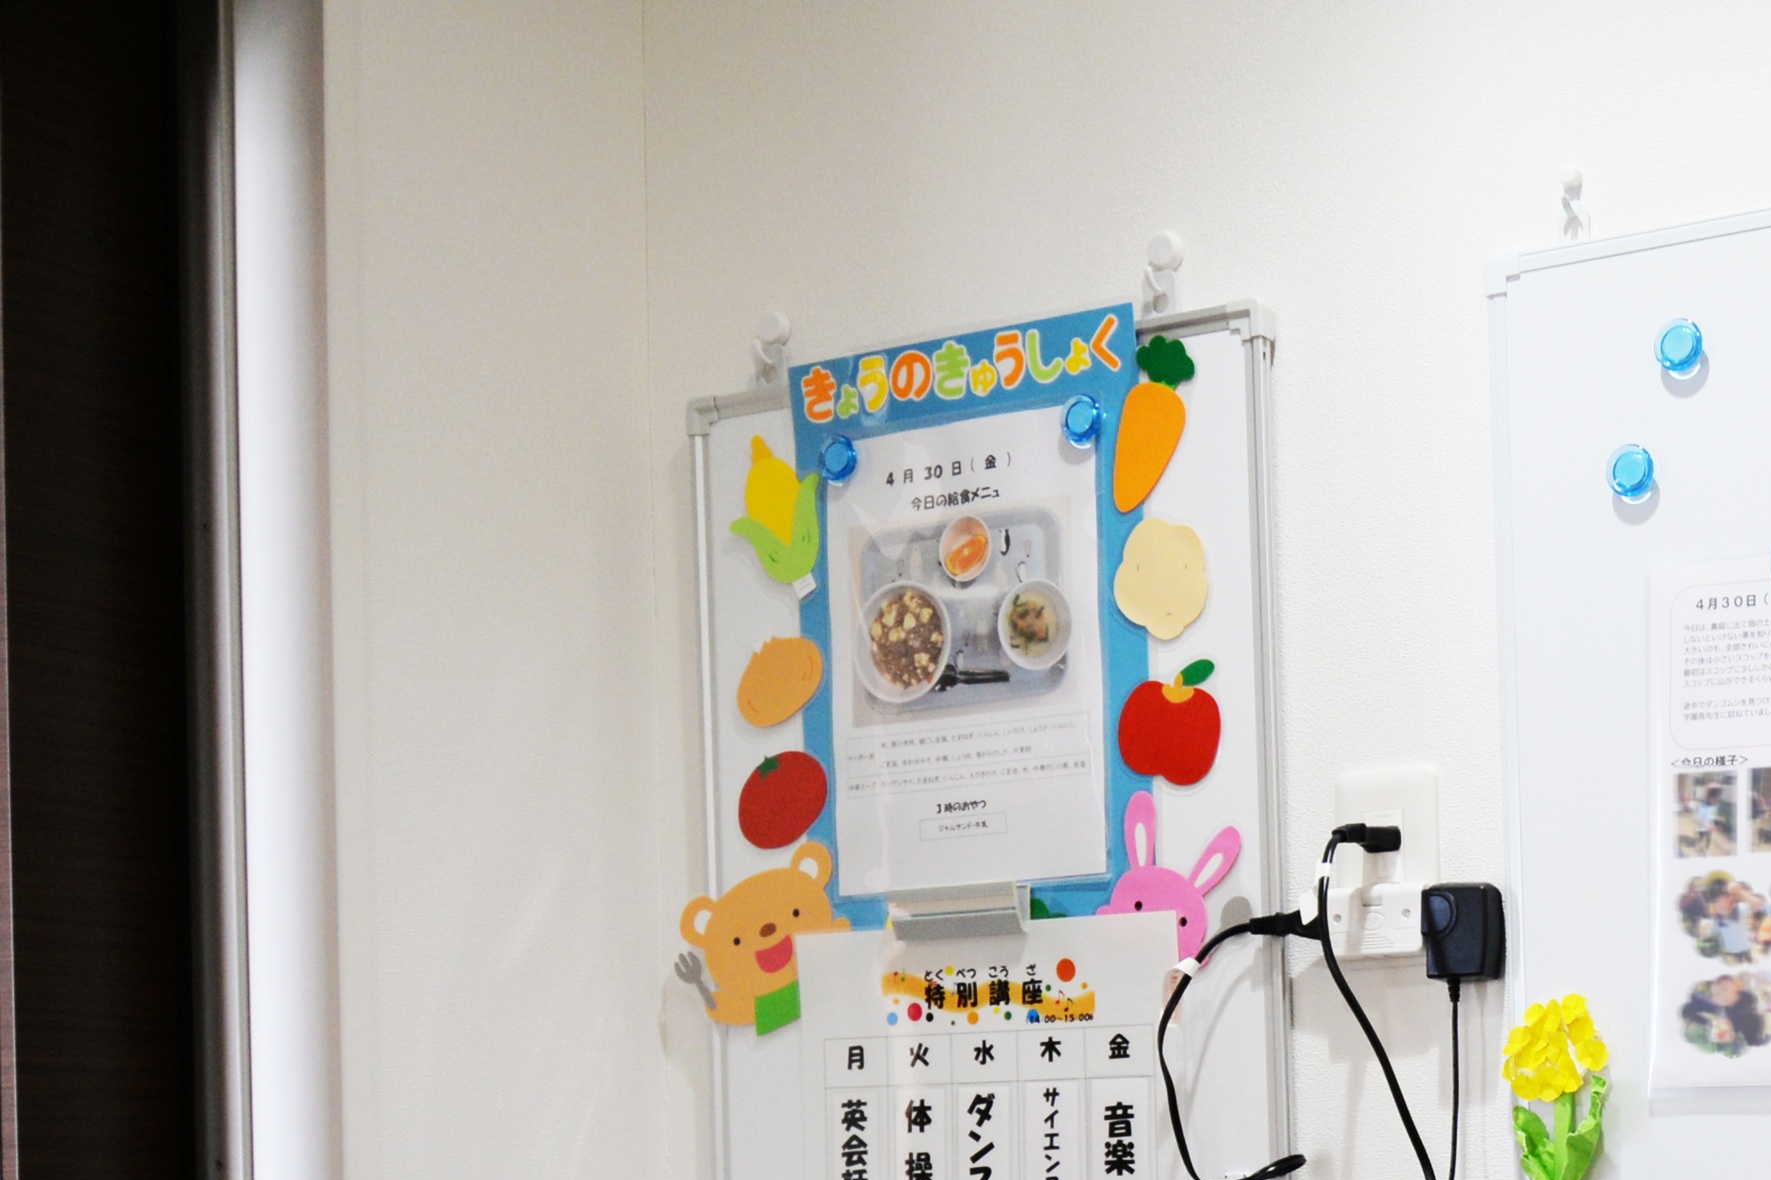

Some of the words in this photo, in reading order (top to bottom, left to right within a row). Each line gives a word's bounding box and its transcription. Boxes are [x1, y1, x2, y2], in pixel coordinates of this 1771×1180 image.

[801, 314, 1121, 423] きょうのきゅうしょく
[924, 968, 944, 981] とく
[989, 965, 1009, 978] こう
[1026, 964, 1037, 976] ざ
[847, 1045, 864, 1070] 月
[909, 1043, 930, 1068] 火
[974, 1040, 995, 1065] 水
[1040, 1037, 1061, 1062] 木
[1108, 1033, 1130, 1059] 金
[1104, 1102, 1135, 1176] 音楽
